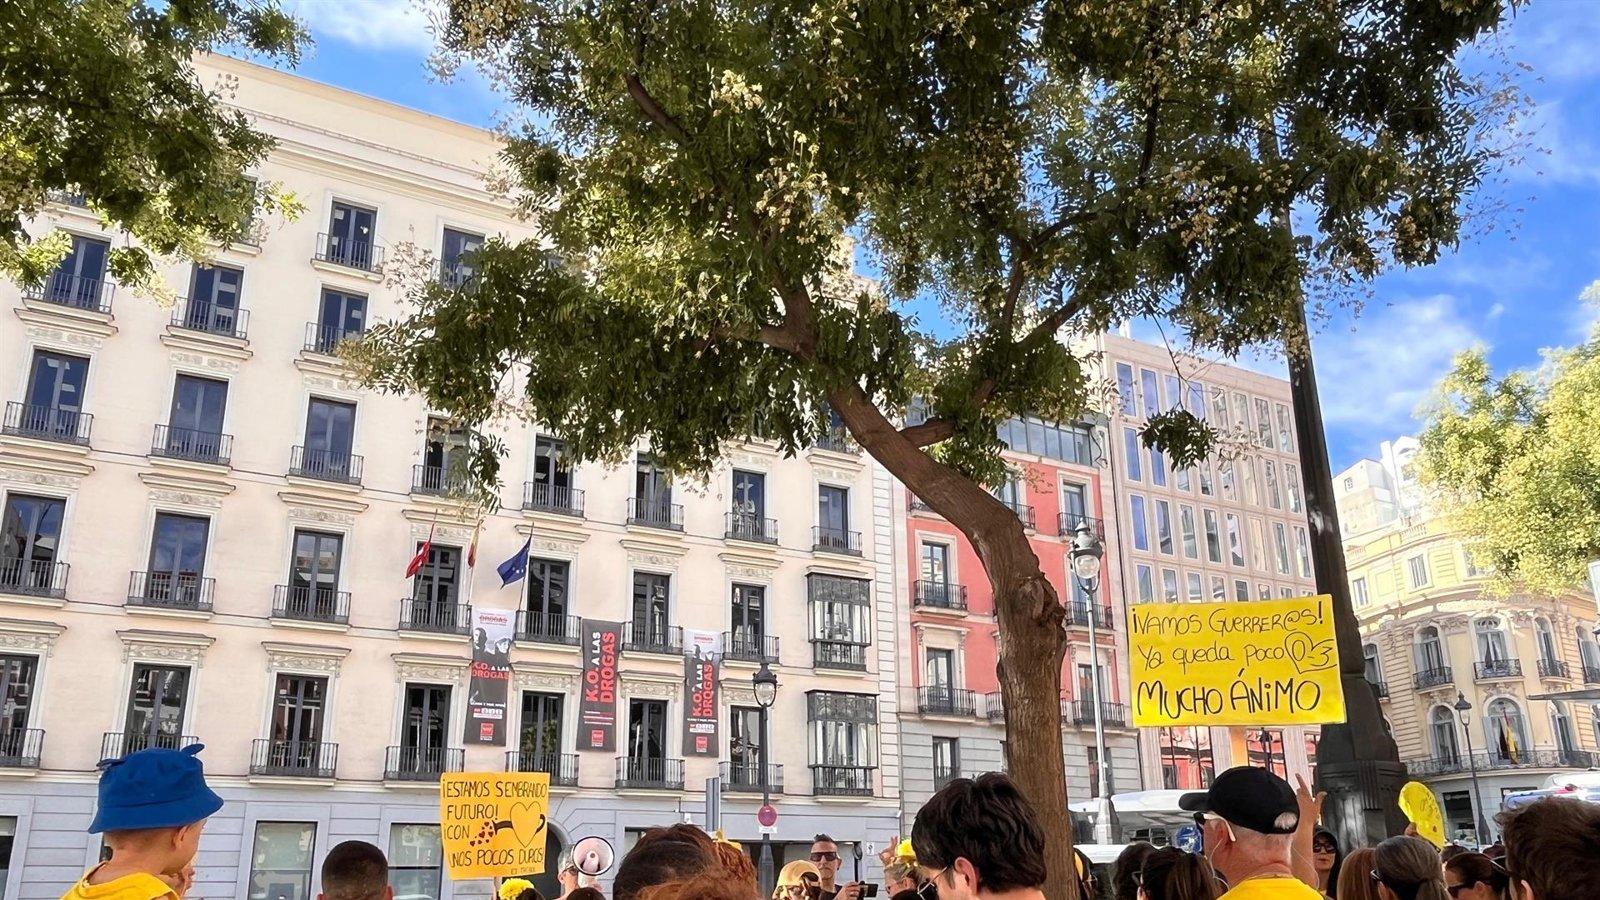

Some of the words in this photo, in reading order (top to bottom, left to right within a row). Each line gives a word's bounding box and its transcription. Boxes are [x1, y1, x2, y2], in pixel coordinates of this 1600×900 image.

[591, 631, 600, 654] LAS
[591, 659, 600, 667] A
[601, 632, 616, 703] DROGAS
[1137, 644, 1164, 671] Ya
[1172, 640, 1235, 675] queda
[585, 666, 599, 702] K.O.
[703, 664, 714, 717] DROGAS
[692, 693, 702, 717] K.O.
[446, 803, 499, 821] FUTURO!
[476, 849, 515, 866] POCOS
